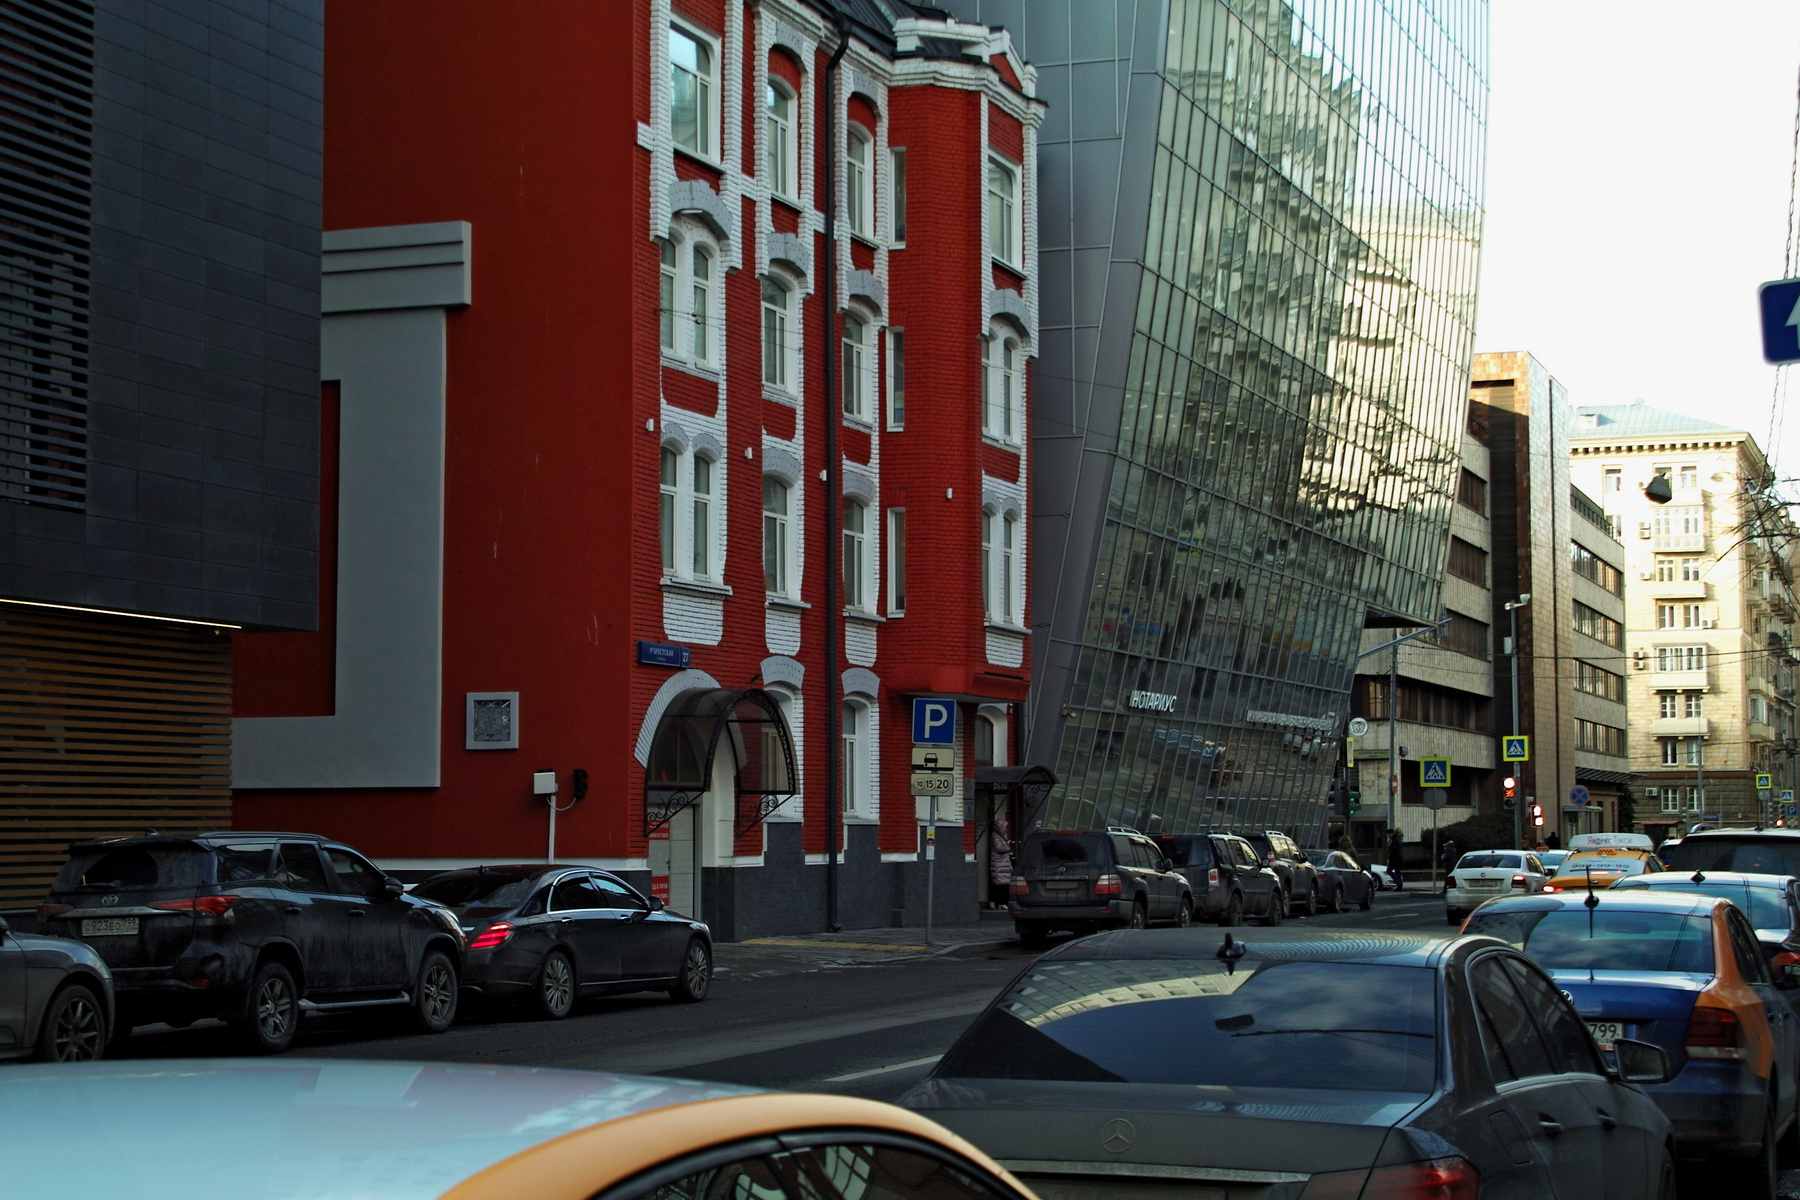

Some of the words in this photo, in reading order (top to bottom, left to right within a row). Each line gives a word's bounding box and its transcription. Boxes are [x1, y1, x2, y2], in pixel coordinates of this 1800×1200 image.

[682, 652, 689, 662] 27
[1131, 690, 1177, 712] НОТАРИУС
[924, 704, 948, 738] P
[925, 780, 934, 789] 15
[936, 779, 949, 789] 20
[1587, 836, 1612, 845] Яндекс
[1613, 835, 1632, 844] Такси
[1589, 1023, 1617, 1038] 799
